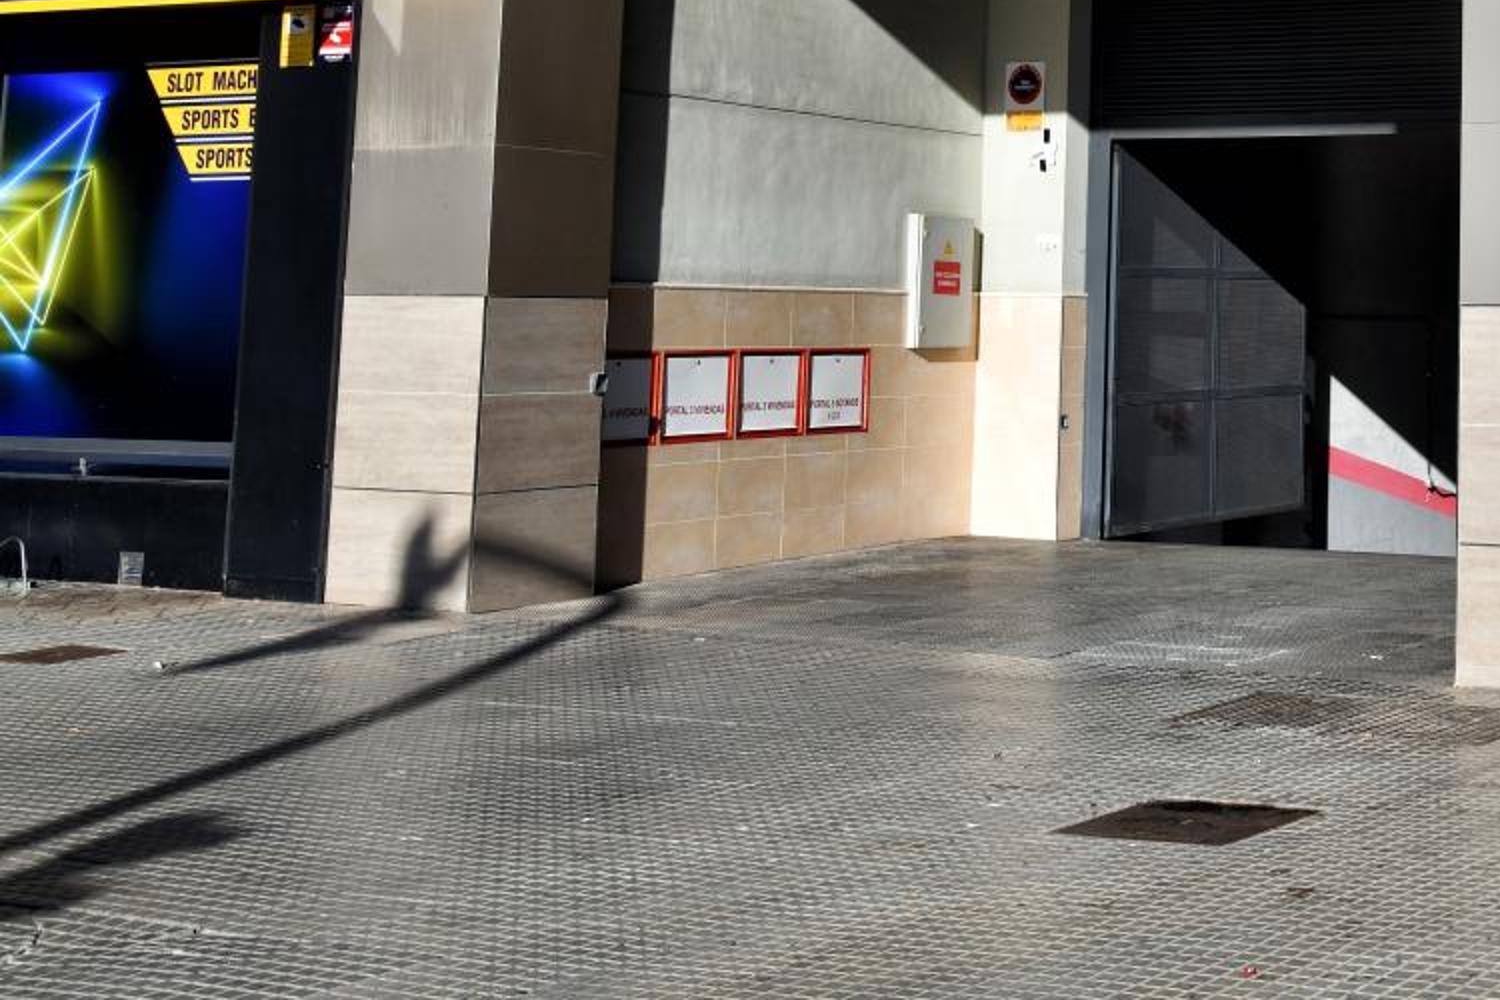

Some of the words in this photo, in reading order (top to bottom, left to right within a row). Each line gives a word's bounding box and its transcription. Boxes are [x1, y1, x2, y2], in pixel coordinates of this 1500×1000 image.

[166, 71, 204, 93] SLOT
[212, 69, 257, 91] MACH
[181, 107, 239, 131] SPORTS
[195, 147, 254, 169] SPORTS
